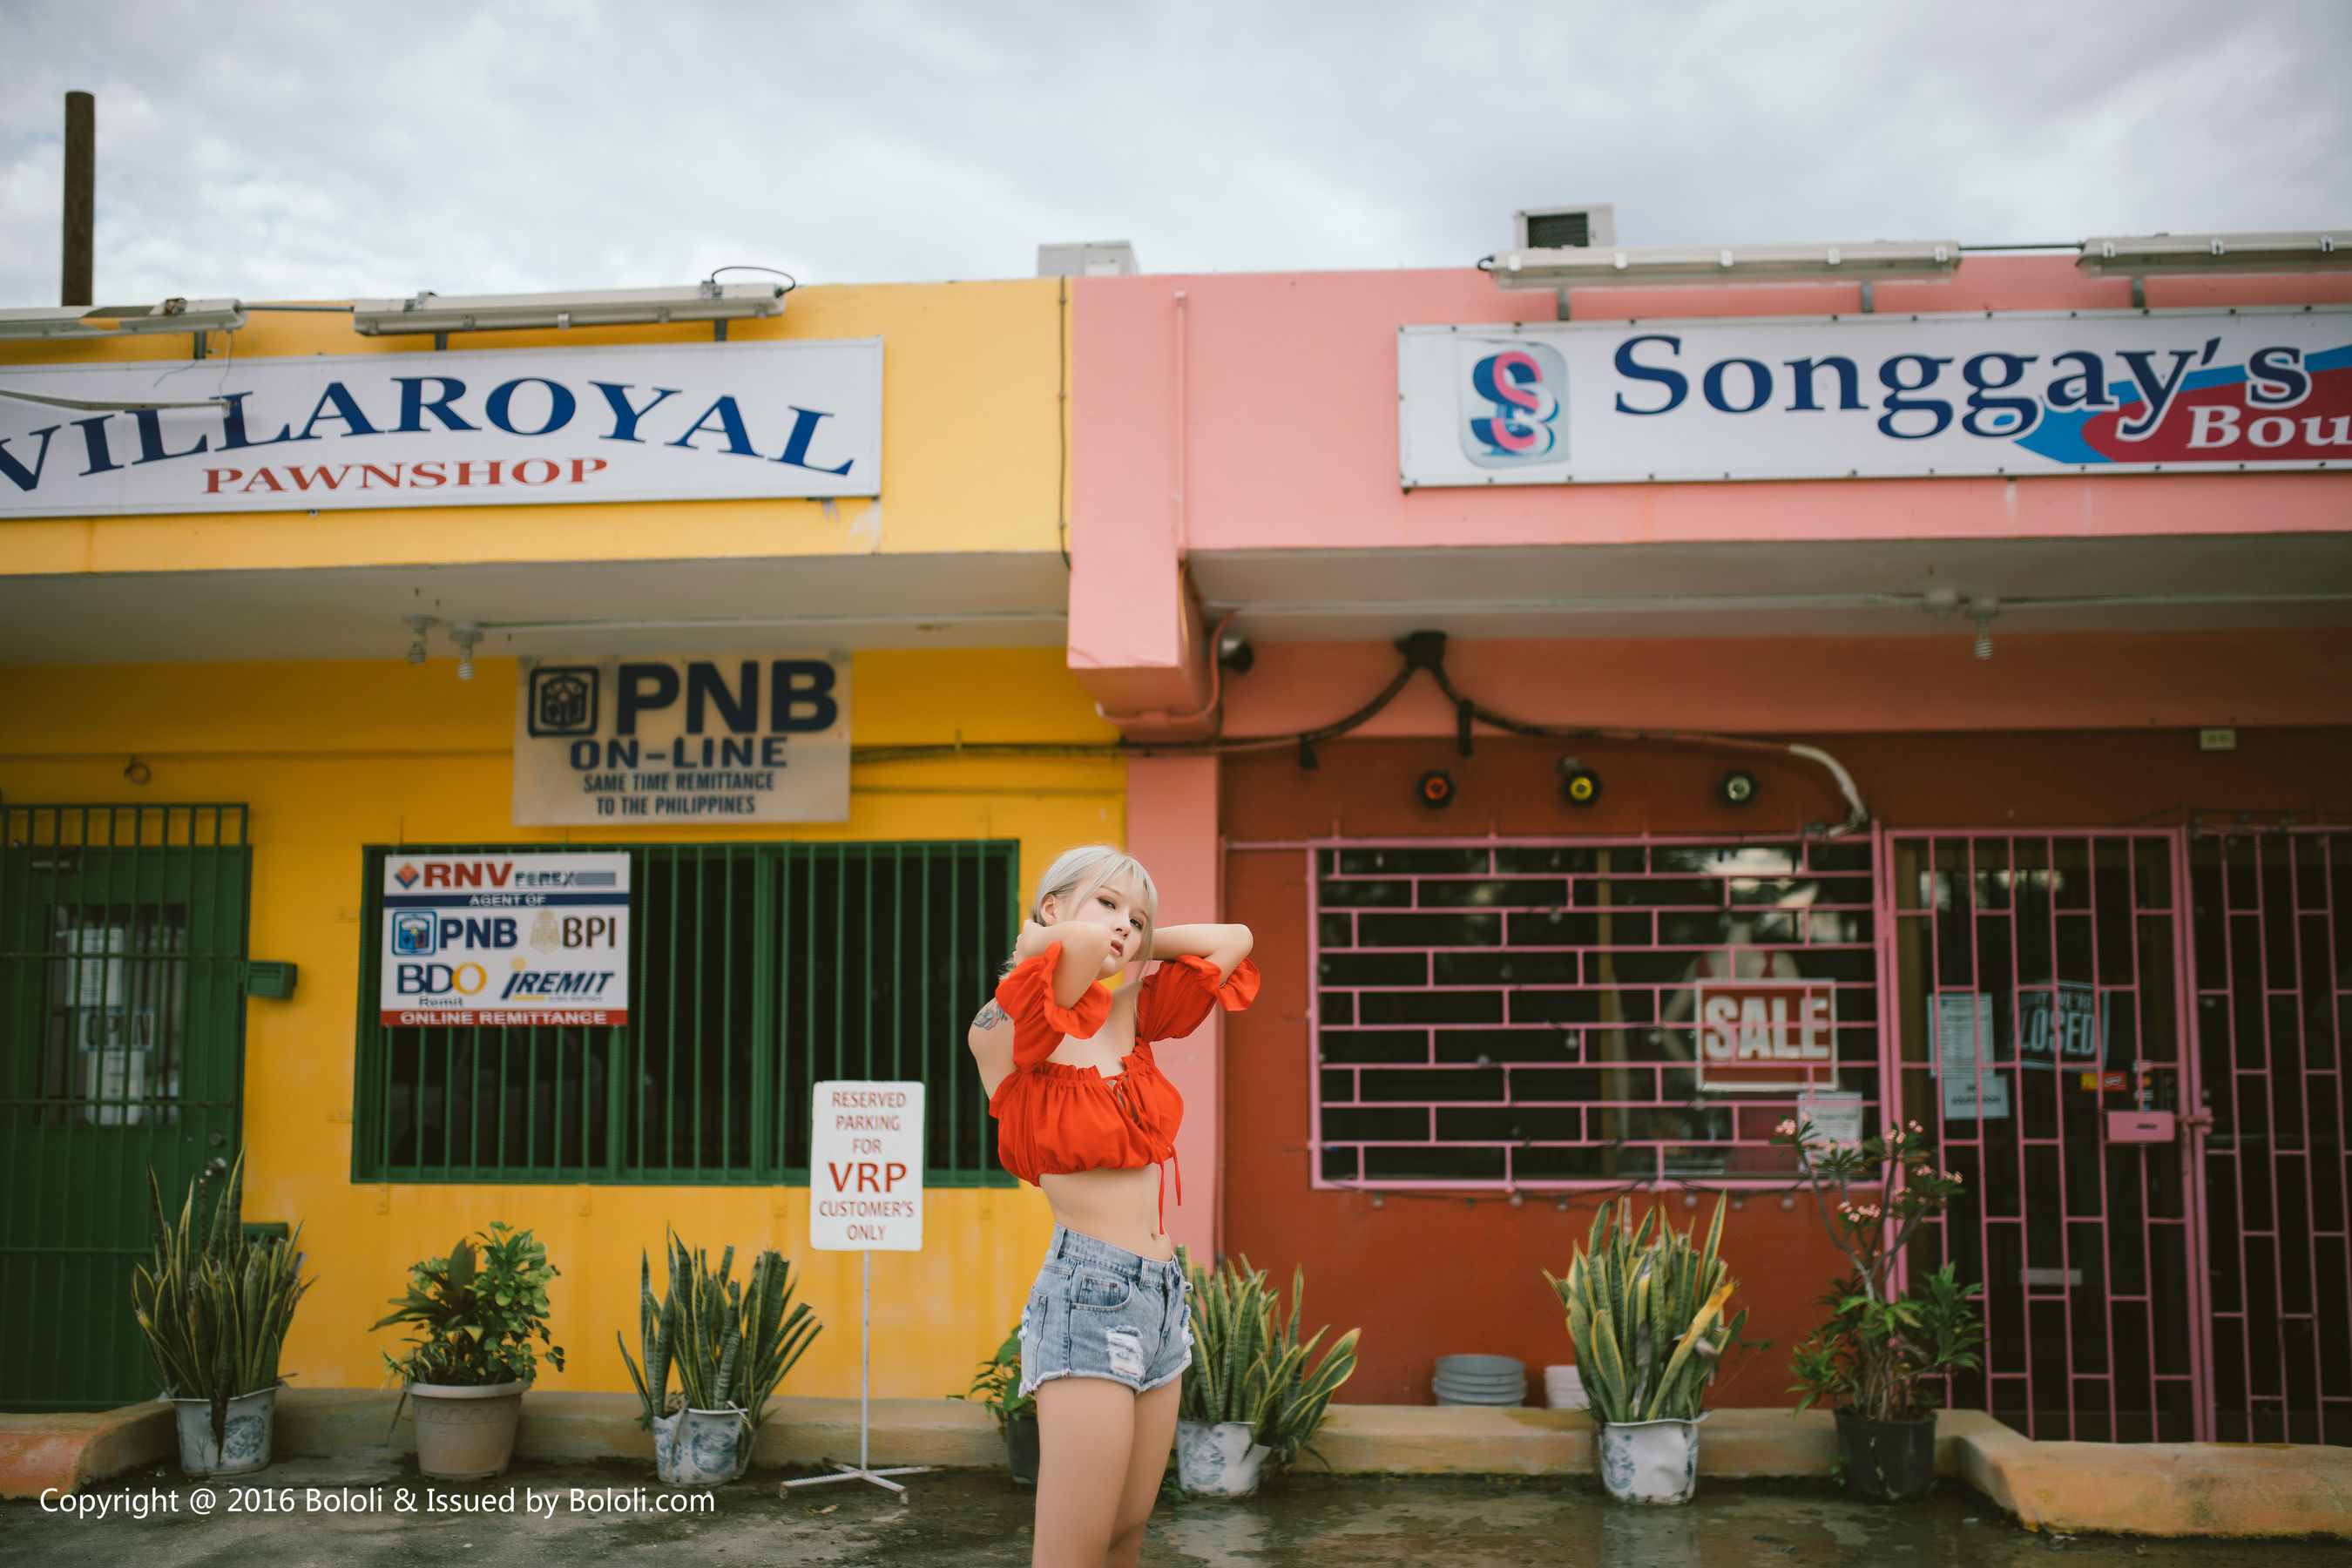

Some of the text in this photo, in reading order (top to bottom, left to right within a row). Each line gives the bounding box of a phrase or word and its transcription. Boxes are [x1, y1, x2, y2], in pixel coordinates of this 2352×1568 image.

[1612, 334, 2310, 442] Songgay's
[0, 375, 855, 492] VILLAROYAL
[200, 456, 609, 495] PAWNSHOP
[616, 659, 838, 735] PNB
[570, 736, 787, 770] ON-LINE
[584, 771, 774, 794] SAME TIME REMITTANCE
[597, 794, 755, 816] TO THE PHILIPPINES
[423, 861, 577, 888] RNV FOREX
[469, 894, 547, 907] AGENT OF
[439, 917, 518, 950] PNB
[563, 917, 616, 949] BPI
[396, 963, 487, 996] BDO
[419, 997, 463, 1008] Remit
[400, 1010, 607, 1025] ONLINE REMITTANCE
[1704, 996, 1830, 1060] SALE
[2011, 1005, 2097, 1057] LOSED
[831, 1091, 907, 1108] RESERVED
[835, 1115, 901, 1132] PARKING
[852, 1138, 882, 1154] FOR
[828, 1162, 908, 1193] VRP
[819, 1200, 915, 1218] CUSTOMER'S
[847, 1224, 886, 1240] ONLY
